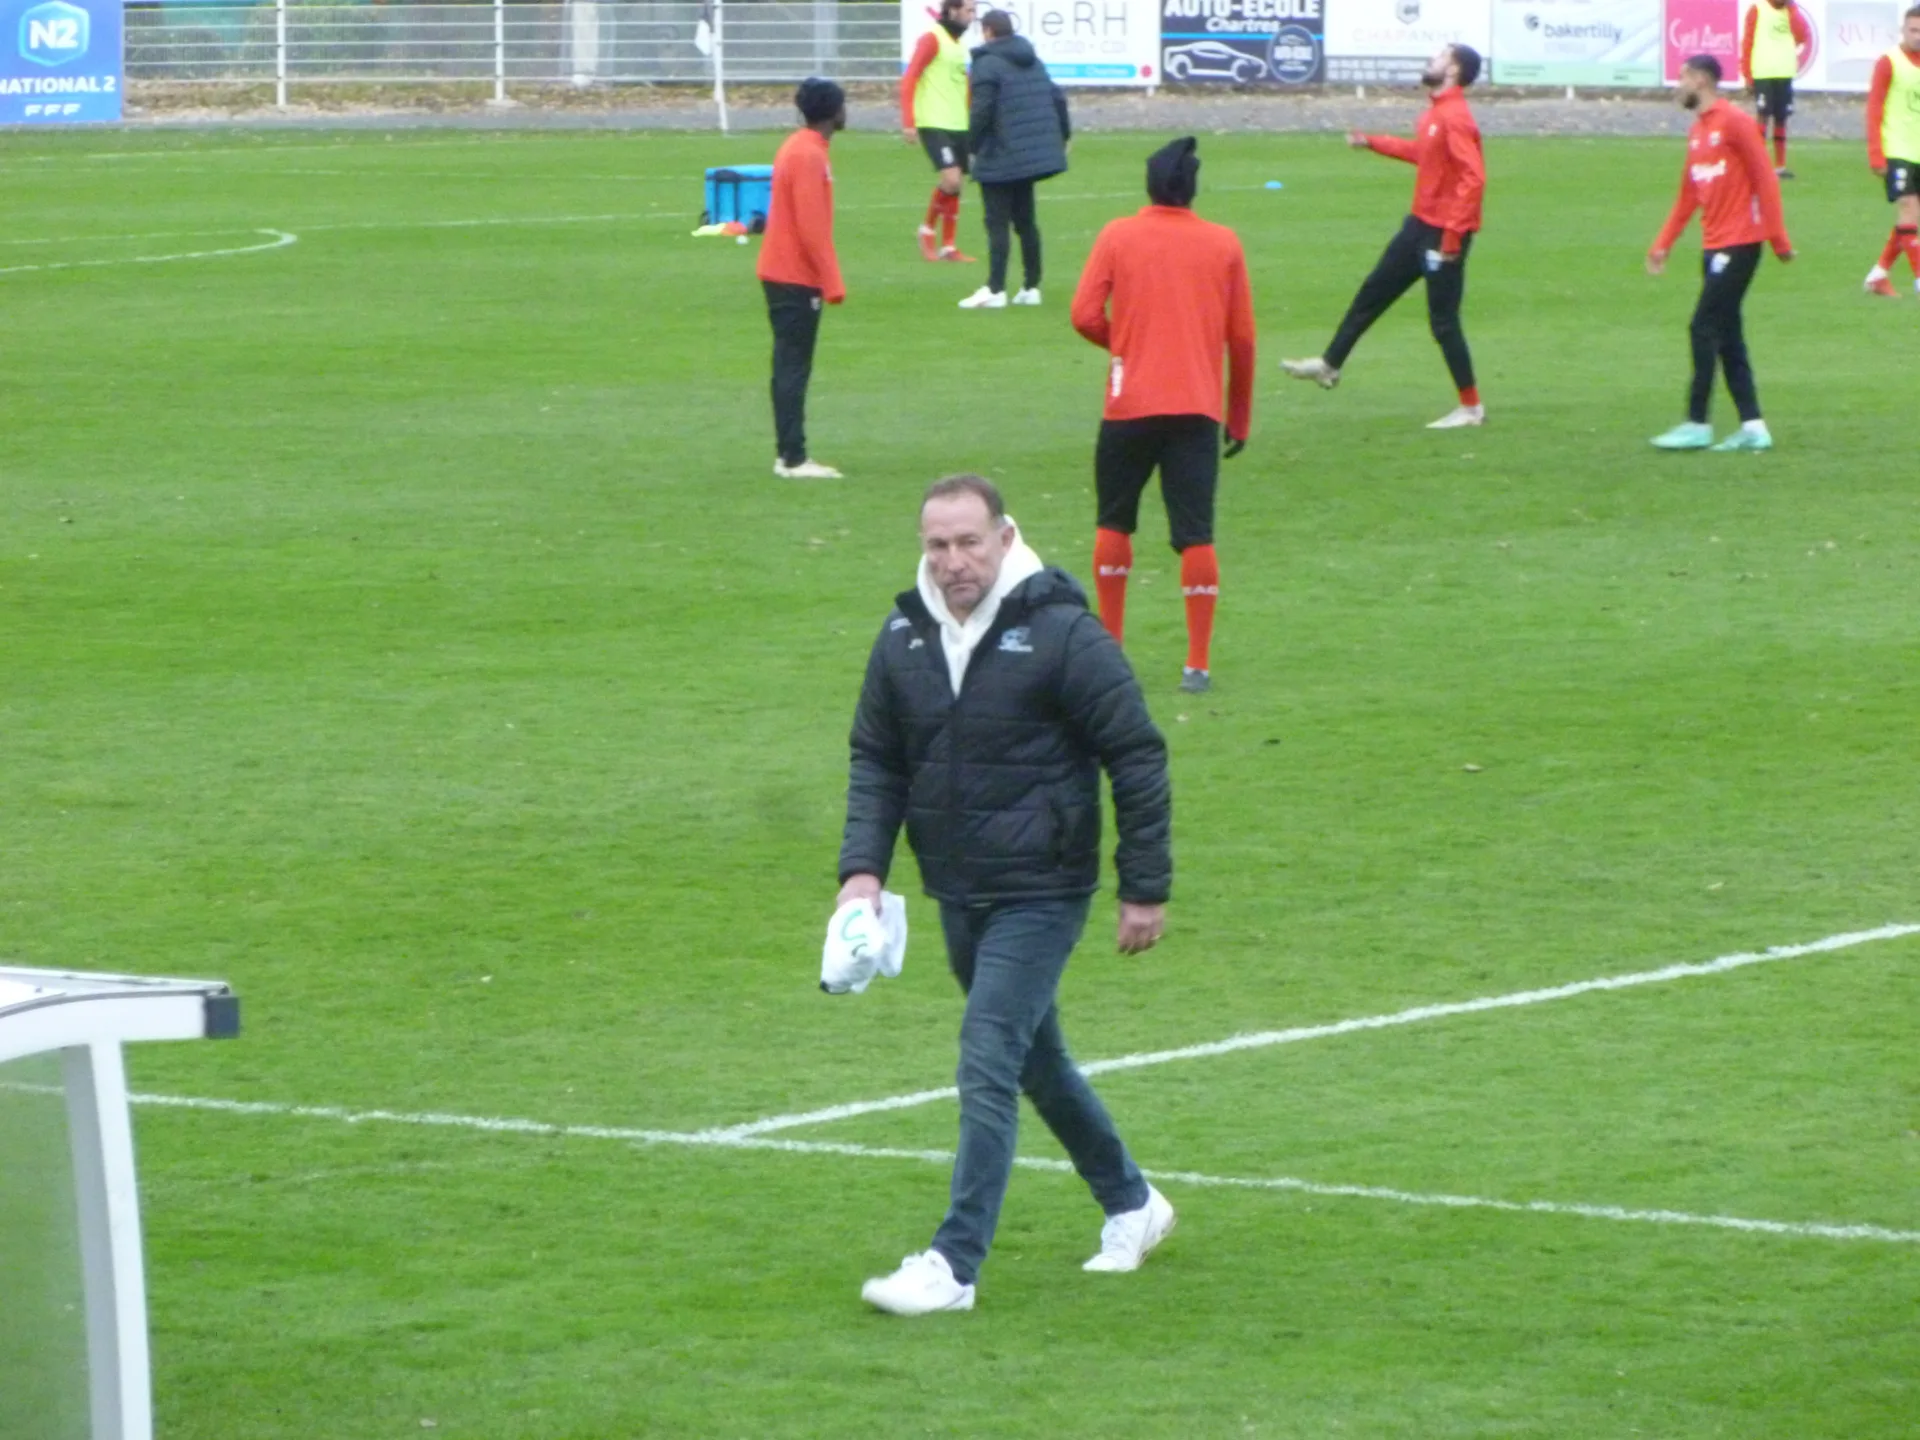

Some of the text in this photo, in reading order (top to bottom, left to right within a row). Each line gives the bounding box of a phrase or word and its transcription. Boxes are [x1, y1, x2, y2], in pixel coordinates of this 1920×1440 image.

[29, 19, 79, 49] N2
[1205, 17, 1282, 33] Chartres
[0, 75, 116, 95] NATIONAL 2
